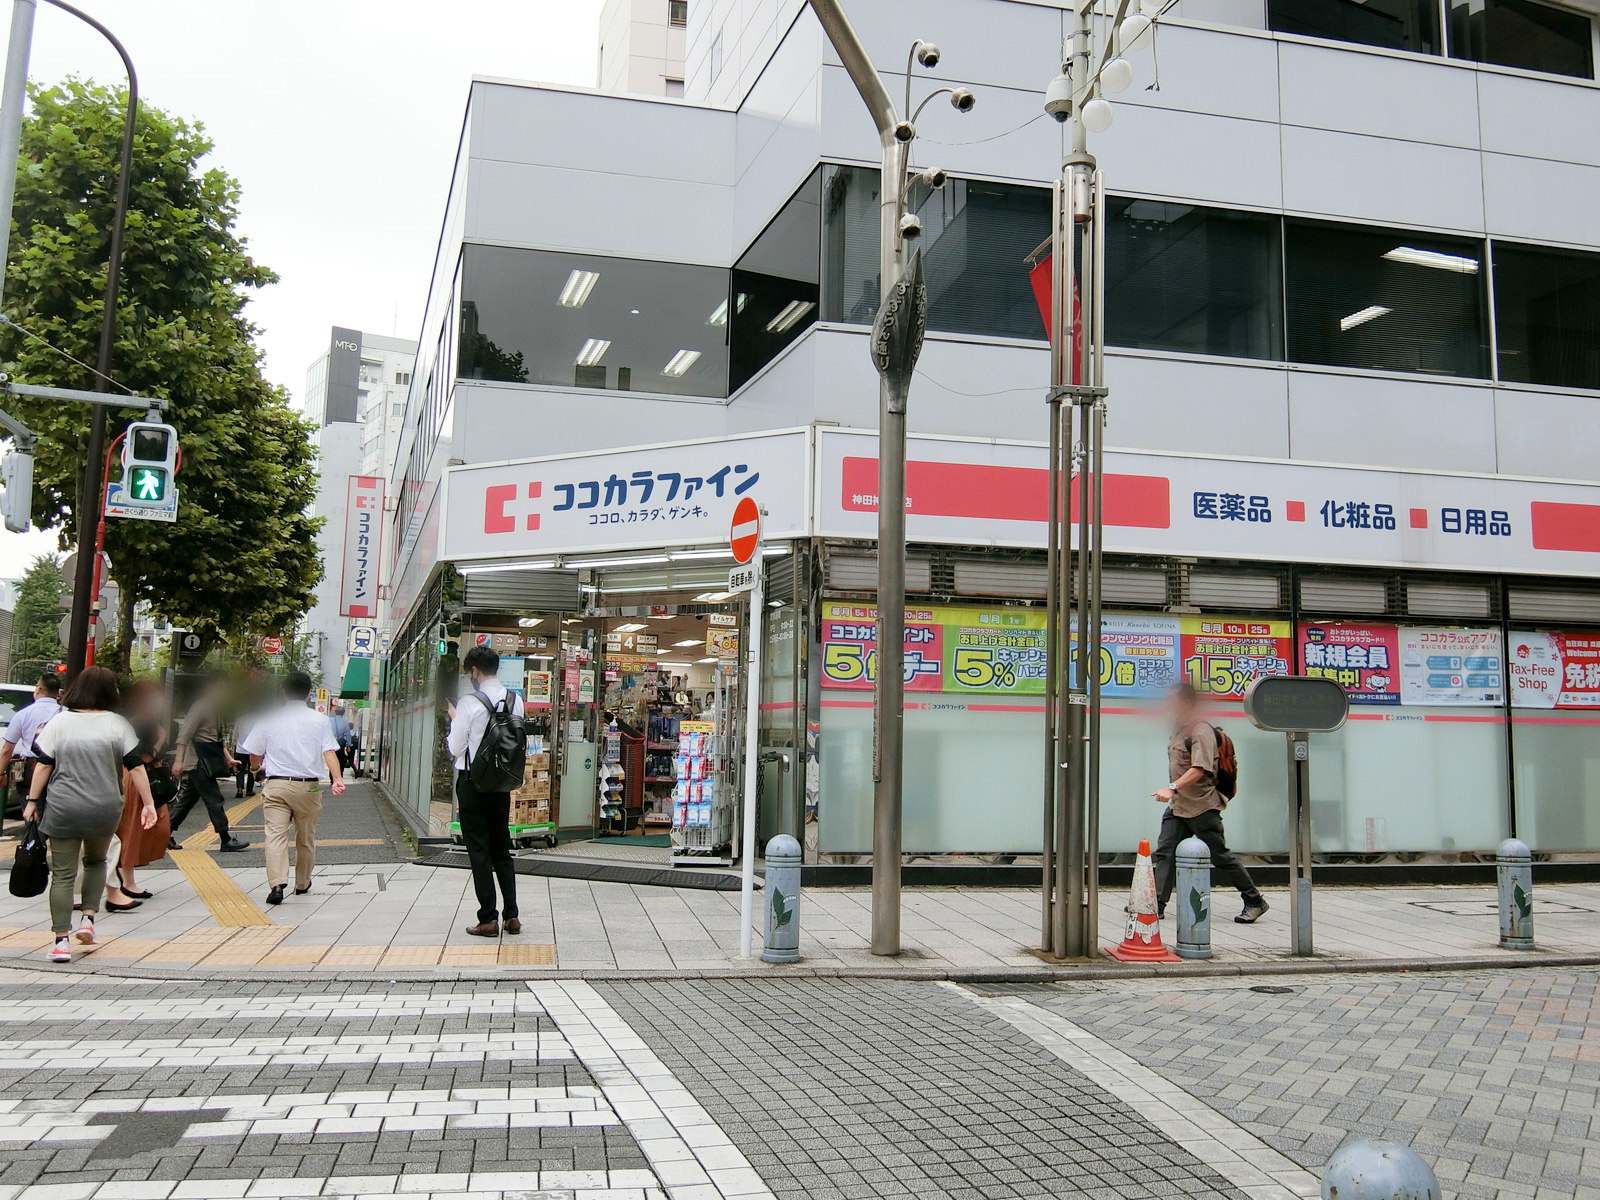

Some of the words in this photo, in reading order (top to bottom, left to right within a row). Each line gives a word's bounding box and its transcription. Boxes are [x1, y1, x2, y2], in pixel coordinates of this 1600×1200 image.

[552, 464, 760, 512] ココカラファイン
[589, 504, 709, 526] ココロ、カラダ、ゲンキ。
[1193, 492, 1272, 522] 医薬品
[1320, 500, 1396, 530] 化粧品
[1441, 507, 1511, 536] 日用品
[355, 512, 370, 599] ココカラファイン
[623, 636, 634, 650] 4
[1101, 633, 1174, 646] ウンセリング化粧品
[1420, 632, 1498, 643] ココカラ公式アプリ
[1138, 658, 1174, 669] ココカラ
[1236, 656, 1288, 671] キャッシュ
[1304, 643, 1389, 669] 新規会員
[953, 647, 1016, 688] 5%
[1138, 668, 1174, 679] ポイント
[1509, 662, 1555, 676] Tax-Free
[1518, 677, 1548, 691] Shop
